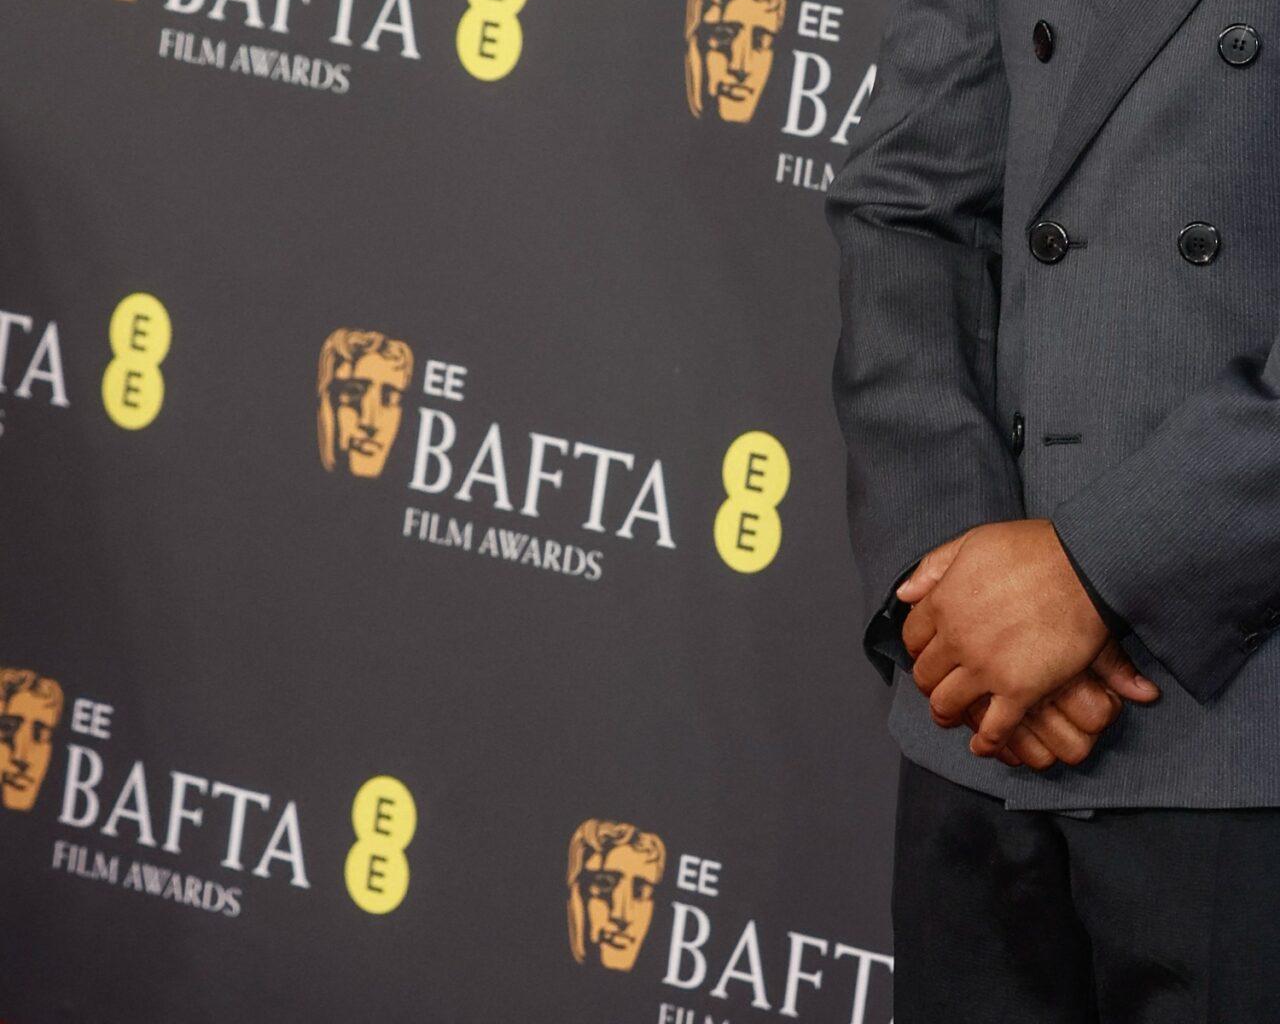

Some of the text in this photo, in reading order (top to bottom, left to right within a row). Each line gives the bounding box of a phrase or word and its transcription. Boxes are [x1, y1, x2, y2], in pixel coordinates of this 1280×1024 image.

[797, 0, 844, 43] EE
[158, 28, 351, 94] FILM AWARDS
[422, 359, 468, 402] EE
[408, 406, 677, 549] BAFTA
[402, 506, 604, 581] FILM AWARDS
[71, 698, 114, 739] EE
[58, 744, 311, 890] BAFTA
[52, 841, 242, 918] FILM AWARDS
[676, 853, 723, 898] EE
